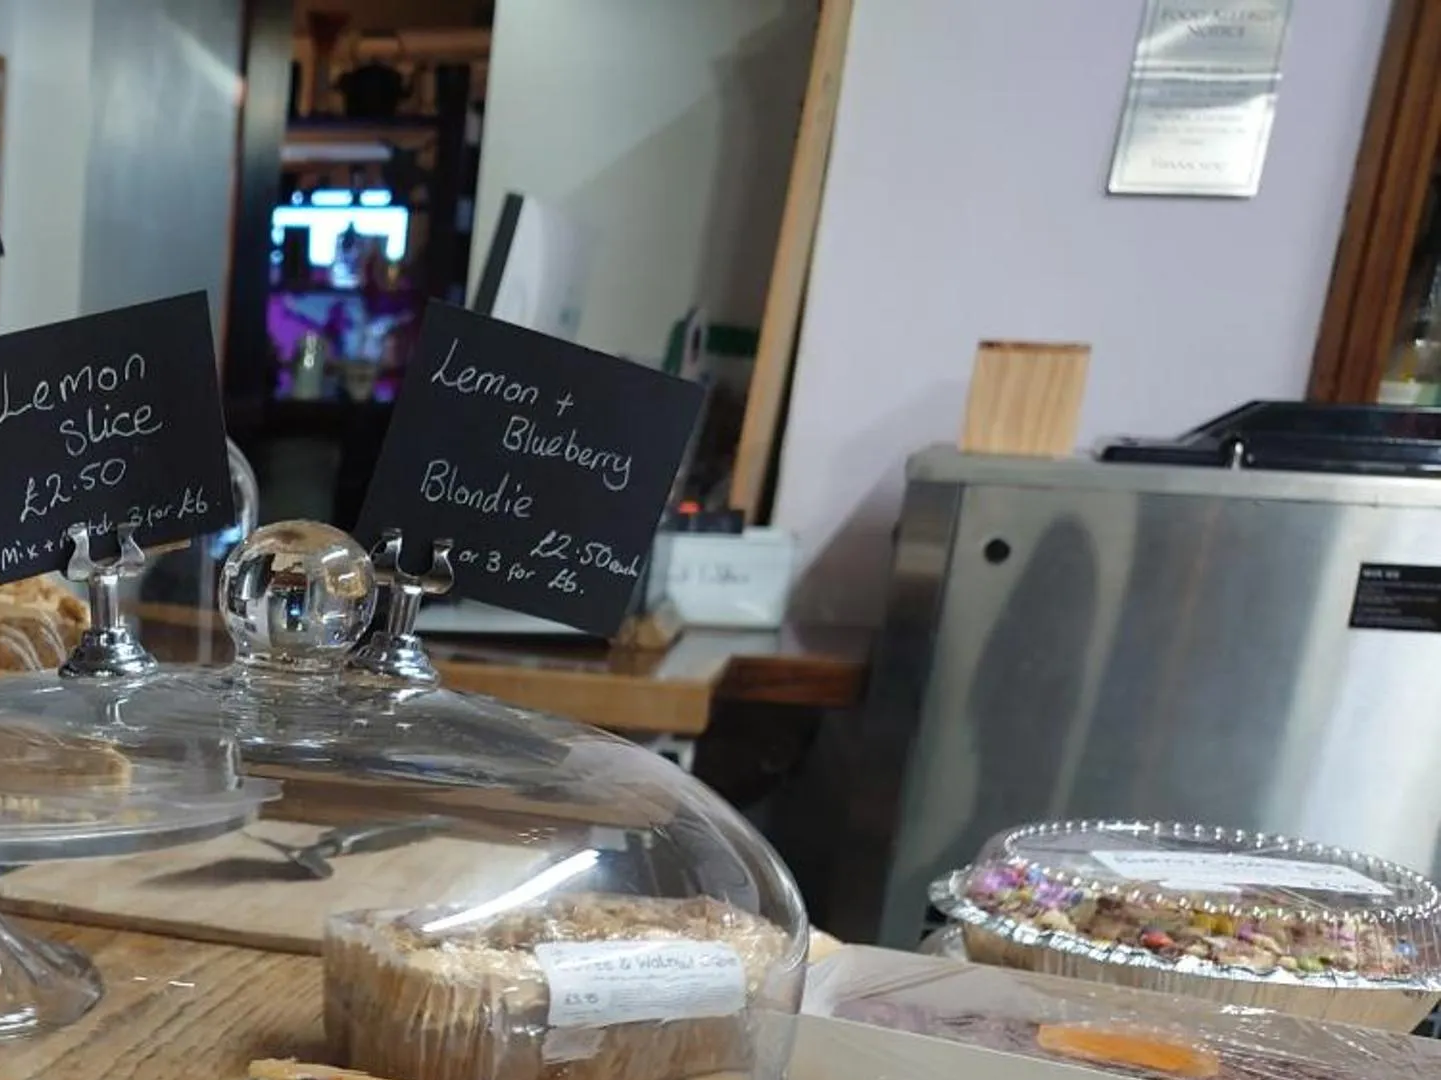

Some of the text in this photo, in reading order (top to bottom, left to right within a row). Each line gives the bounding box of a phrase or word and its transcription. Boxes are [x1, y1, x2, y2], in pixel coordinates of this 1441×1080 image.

[431, 337, 574, 416] Lemon +
[503, 415, 632, 491] Blueberry
[20, 458, 126, 523] £2.50
[420, 459, 535, 518] Blondie
[486, 551, 501, 572] 3
[507, 563, 536, 582] for
[529, 530, 611, 568] £2.50
